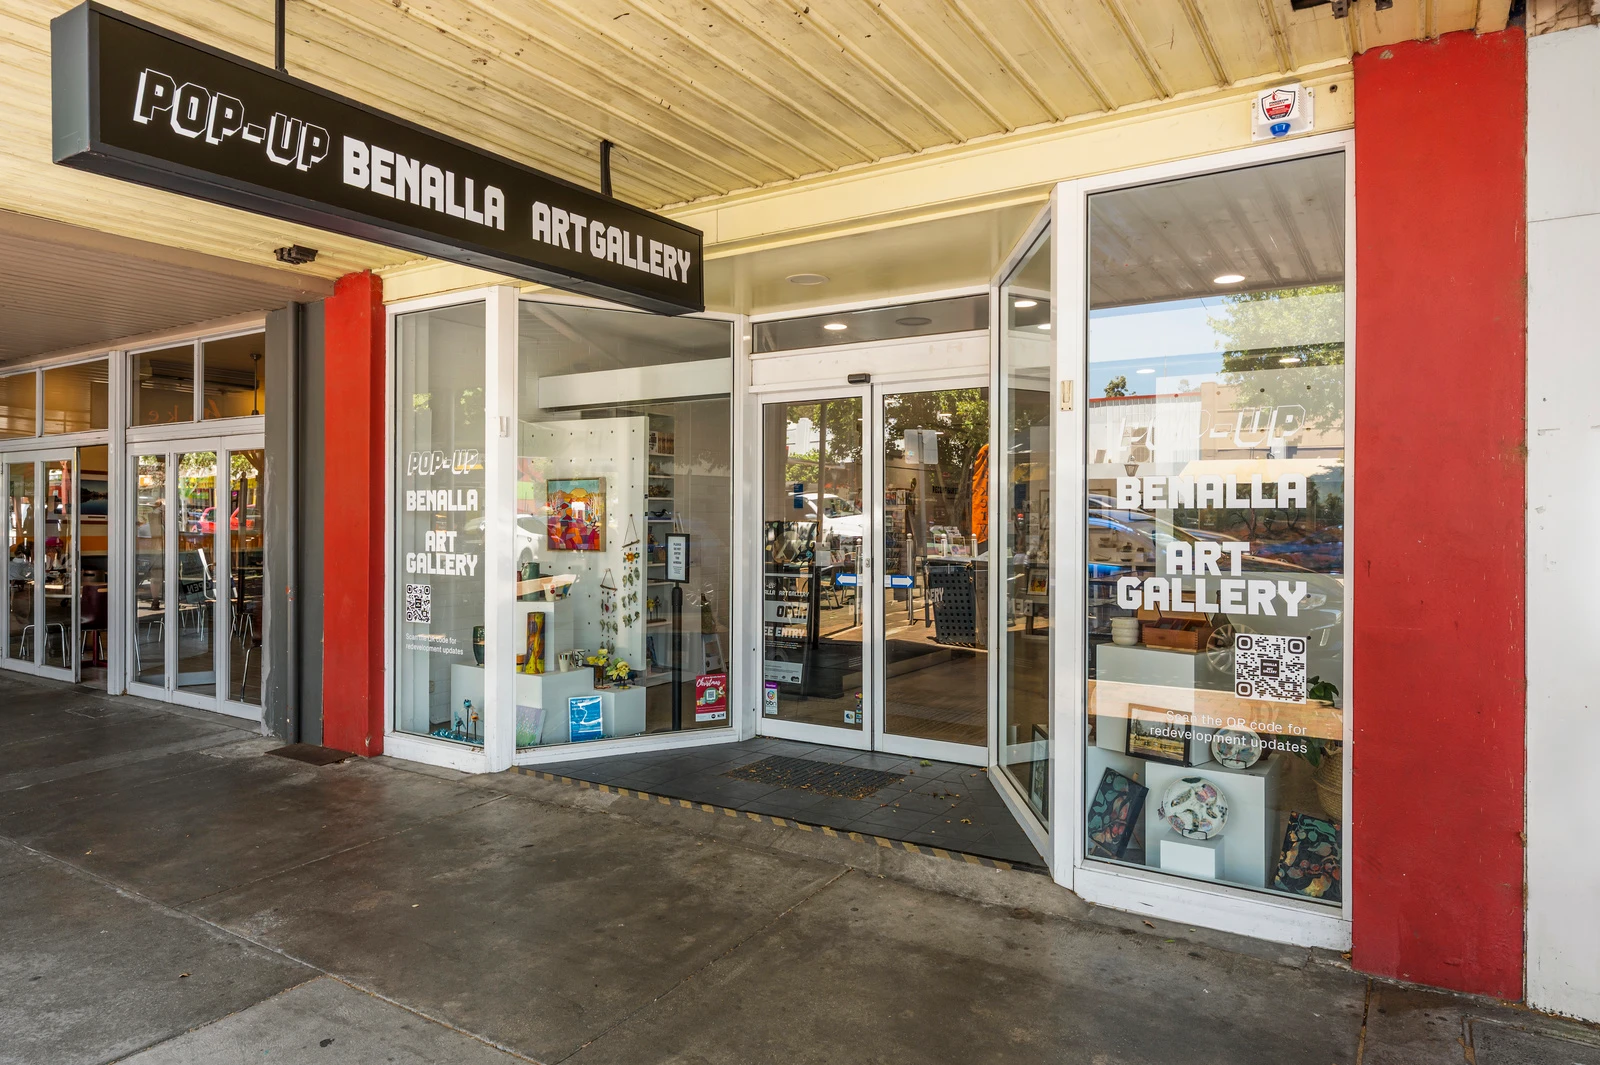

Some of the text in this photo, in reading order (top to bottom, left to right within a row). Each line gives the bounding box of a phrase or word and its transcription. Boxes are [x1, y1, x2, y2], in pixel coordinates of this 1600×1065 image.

[133, 68, 691, 284] POP-UP BENALLA ART GALLERY
[1120, 404, 1306, 448] P-UP
[407, 449, 479, 476] POP-UP
[406, 489, 478, 512] BENALLA
[1116, 474, 1307, 509] BENALLA
[425, 531, 457, 552] ART
[406, 552, 478, 577] GALLERY
[1166, 541, 1250, 577] ART
[1117, 576, 1308, 617] GALLERY
[775, 626, 805, 639] ENTRY
[405, 643, 464, 655] redevelopment updates
[1166, 710, 1308, 735] Scan the QR code for
[1150, 725, 1308, 754] redevelopment updates
